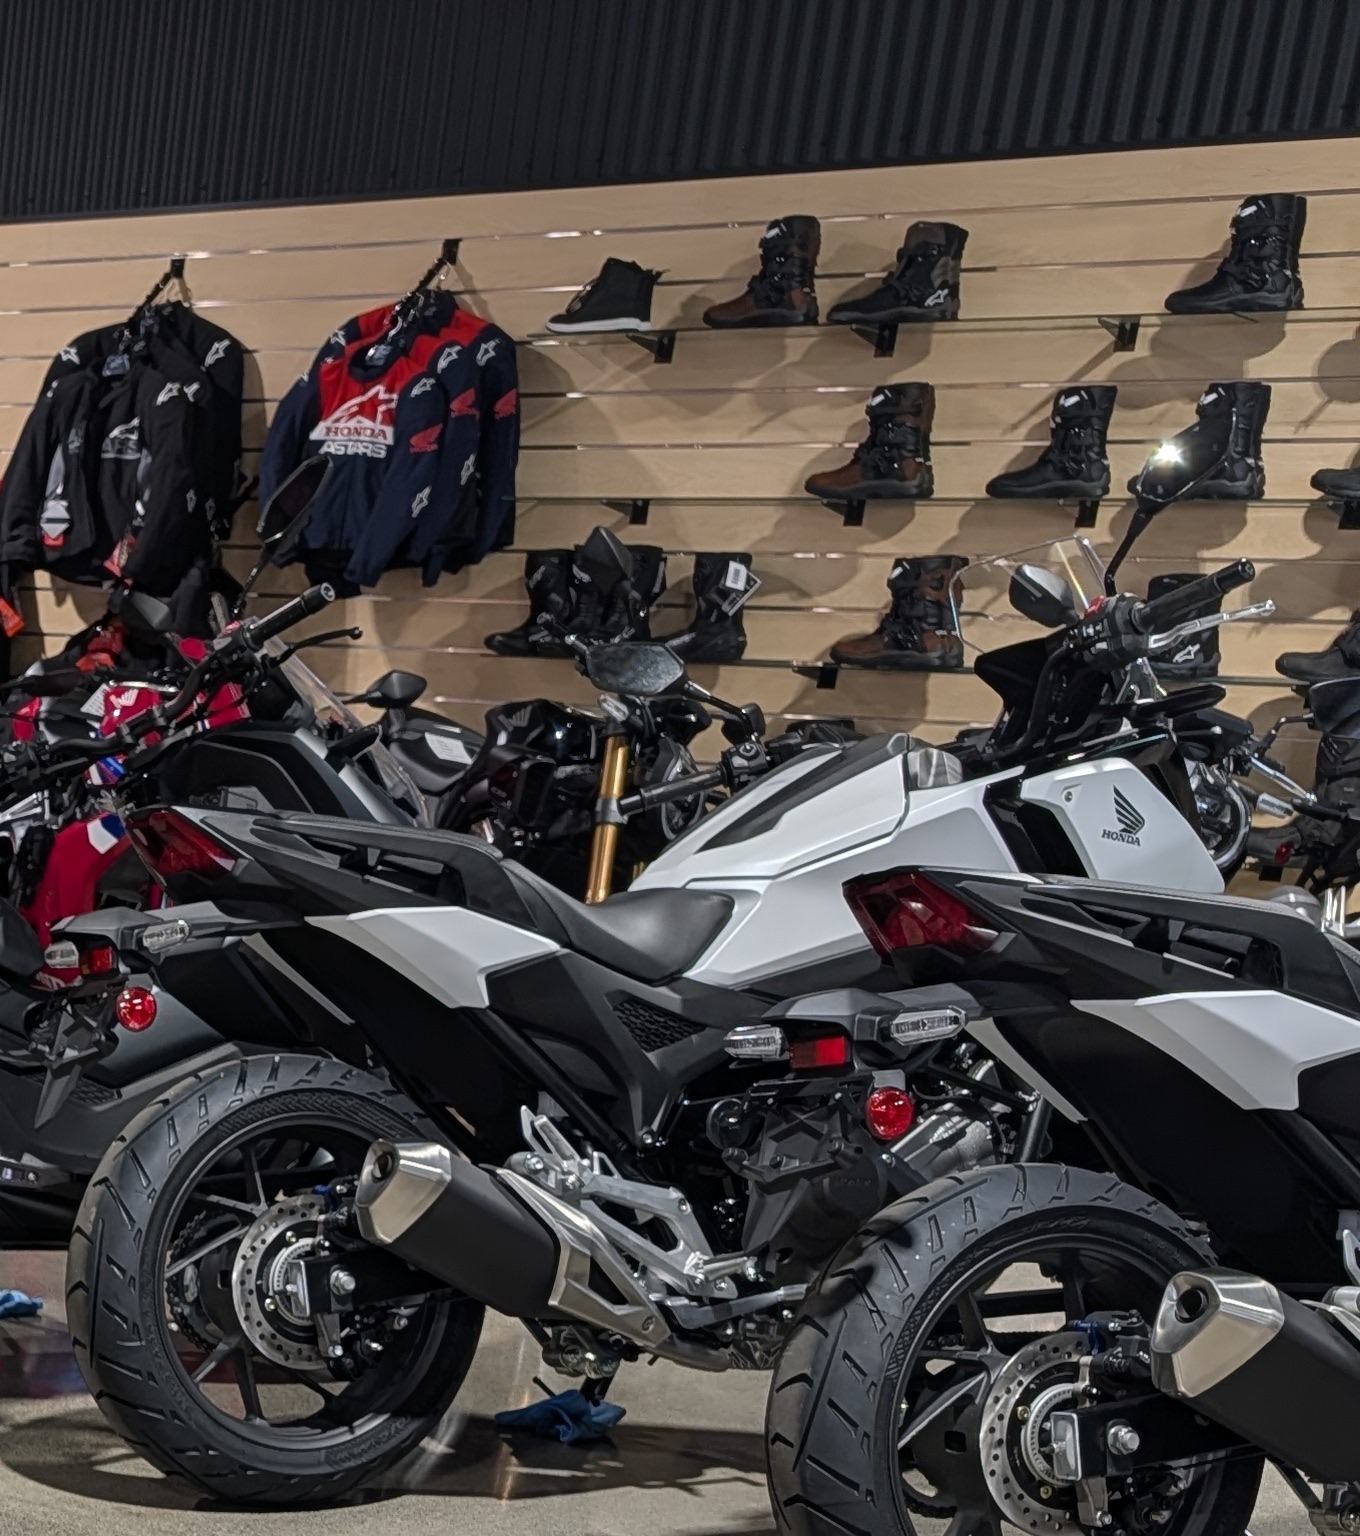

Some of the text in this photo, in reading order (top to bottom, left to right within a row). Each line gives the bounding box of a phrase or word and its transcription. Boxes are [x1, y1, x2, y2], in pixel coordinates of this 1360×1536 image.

[324, 425, 388, 441] HONDA
[318, 441, 388, 459] ASTARS
[1101, 828, 1142, 847] HONDA
